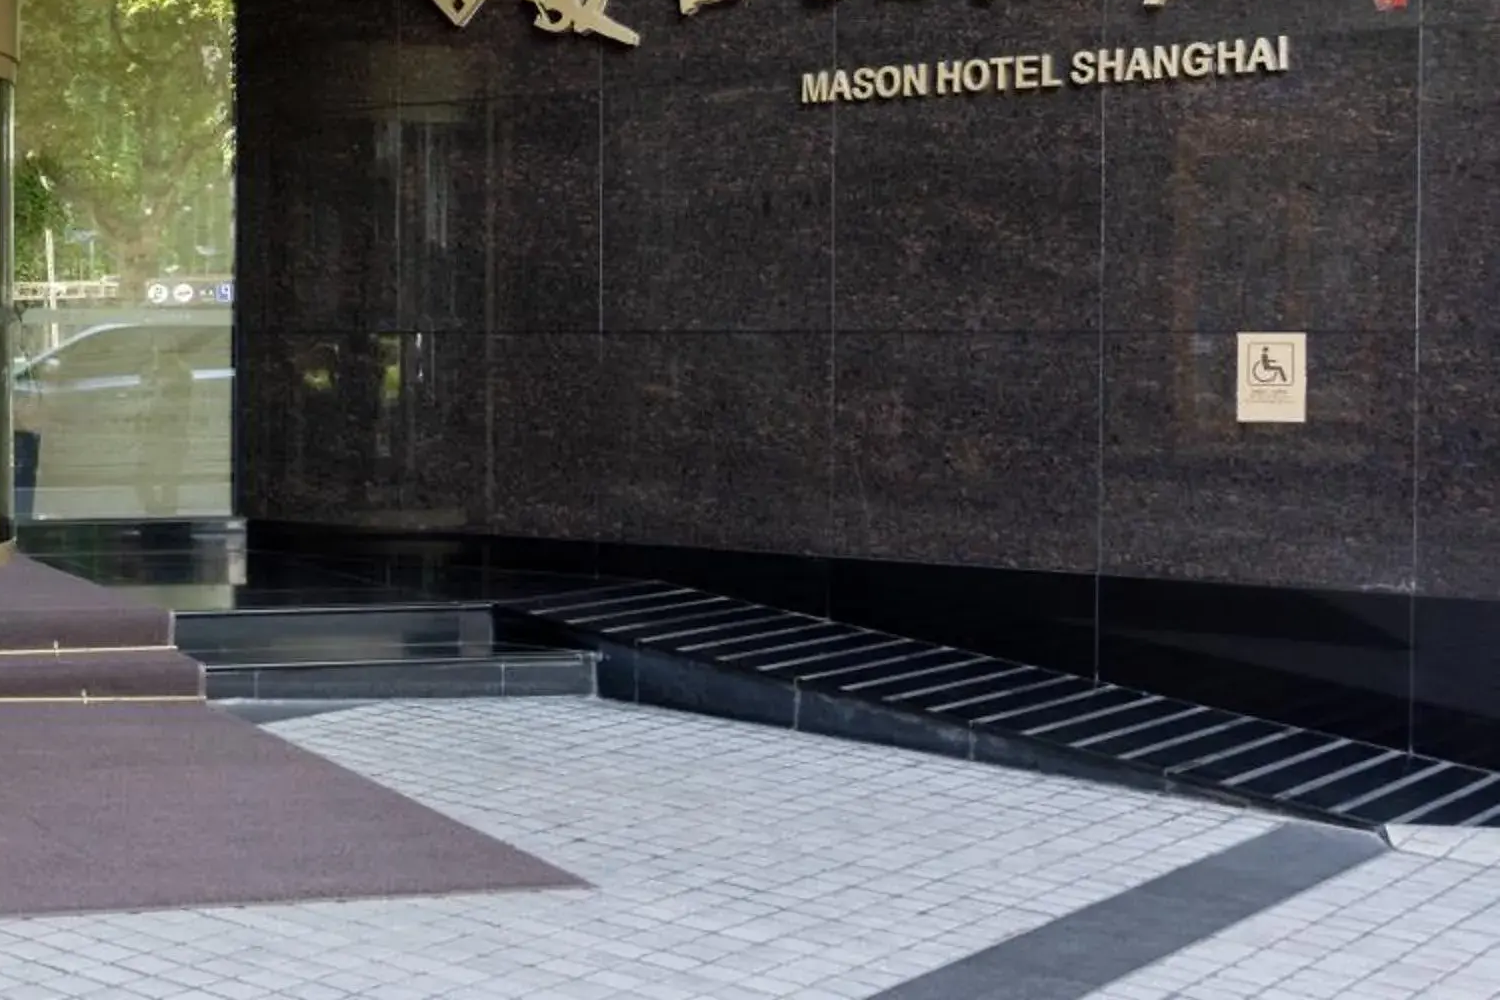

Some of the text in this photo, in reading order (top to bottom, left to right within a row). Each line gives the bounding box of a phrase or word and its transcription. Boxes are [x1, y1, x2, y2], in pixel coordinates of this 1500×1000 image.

[802, 35, 1290, 104] MASON HOTEL SHANGHAI
